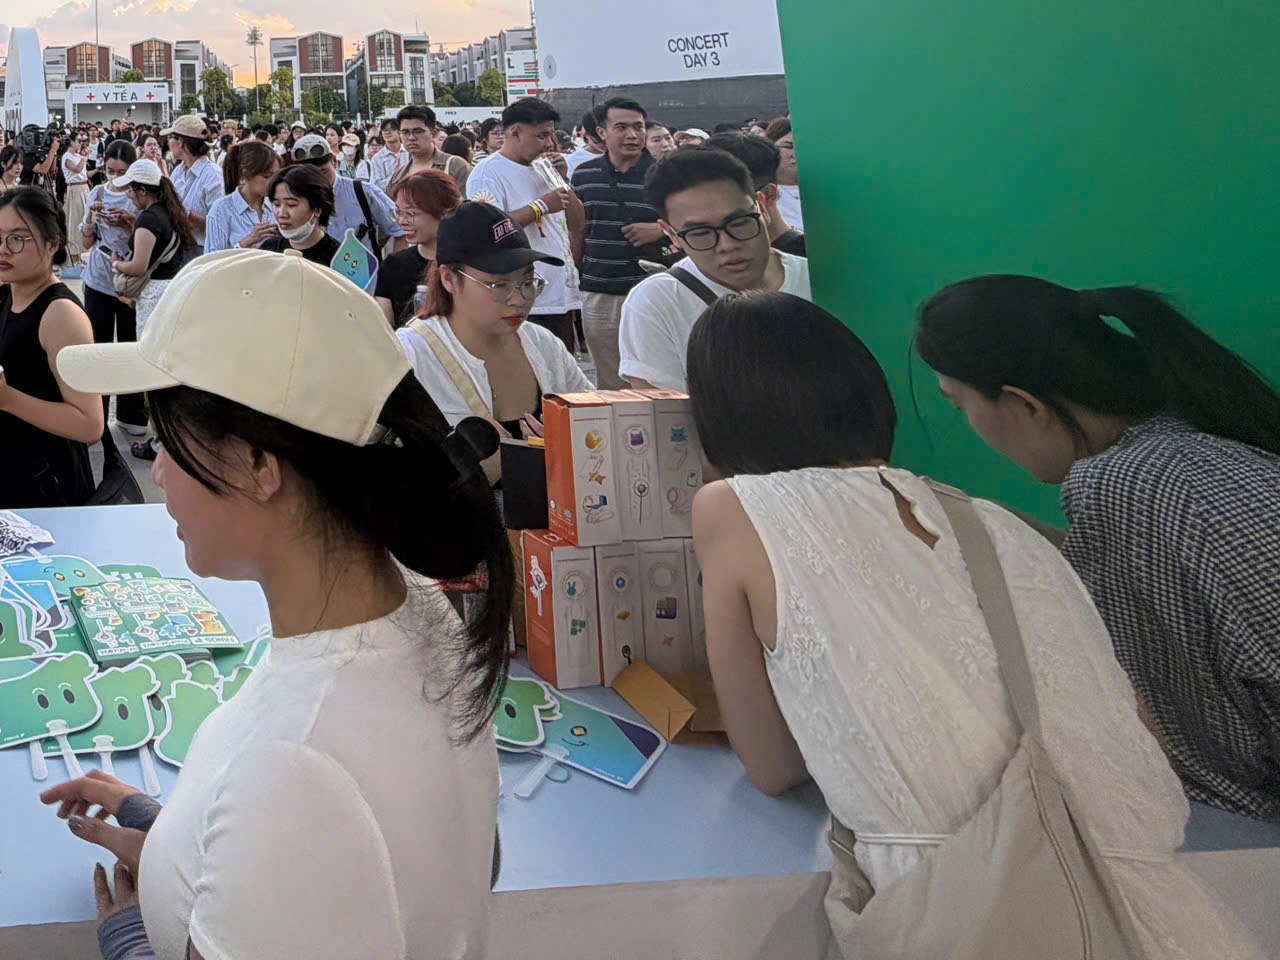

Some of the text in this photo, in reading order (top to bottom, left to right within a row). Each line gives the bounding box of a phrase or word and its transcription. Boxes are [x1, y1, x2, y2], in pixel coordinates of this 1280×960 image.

[667, 32, 729, 53] CONCERT
[683, 51, 721, 68] DAY 3
[102, 92, 110, 102] Y
